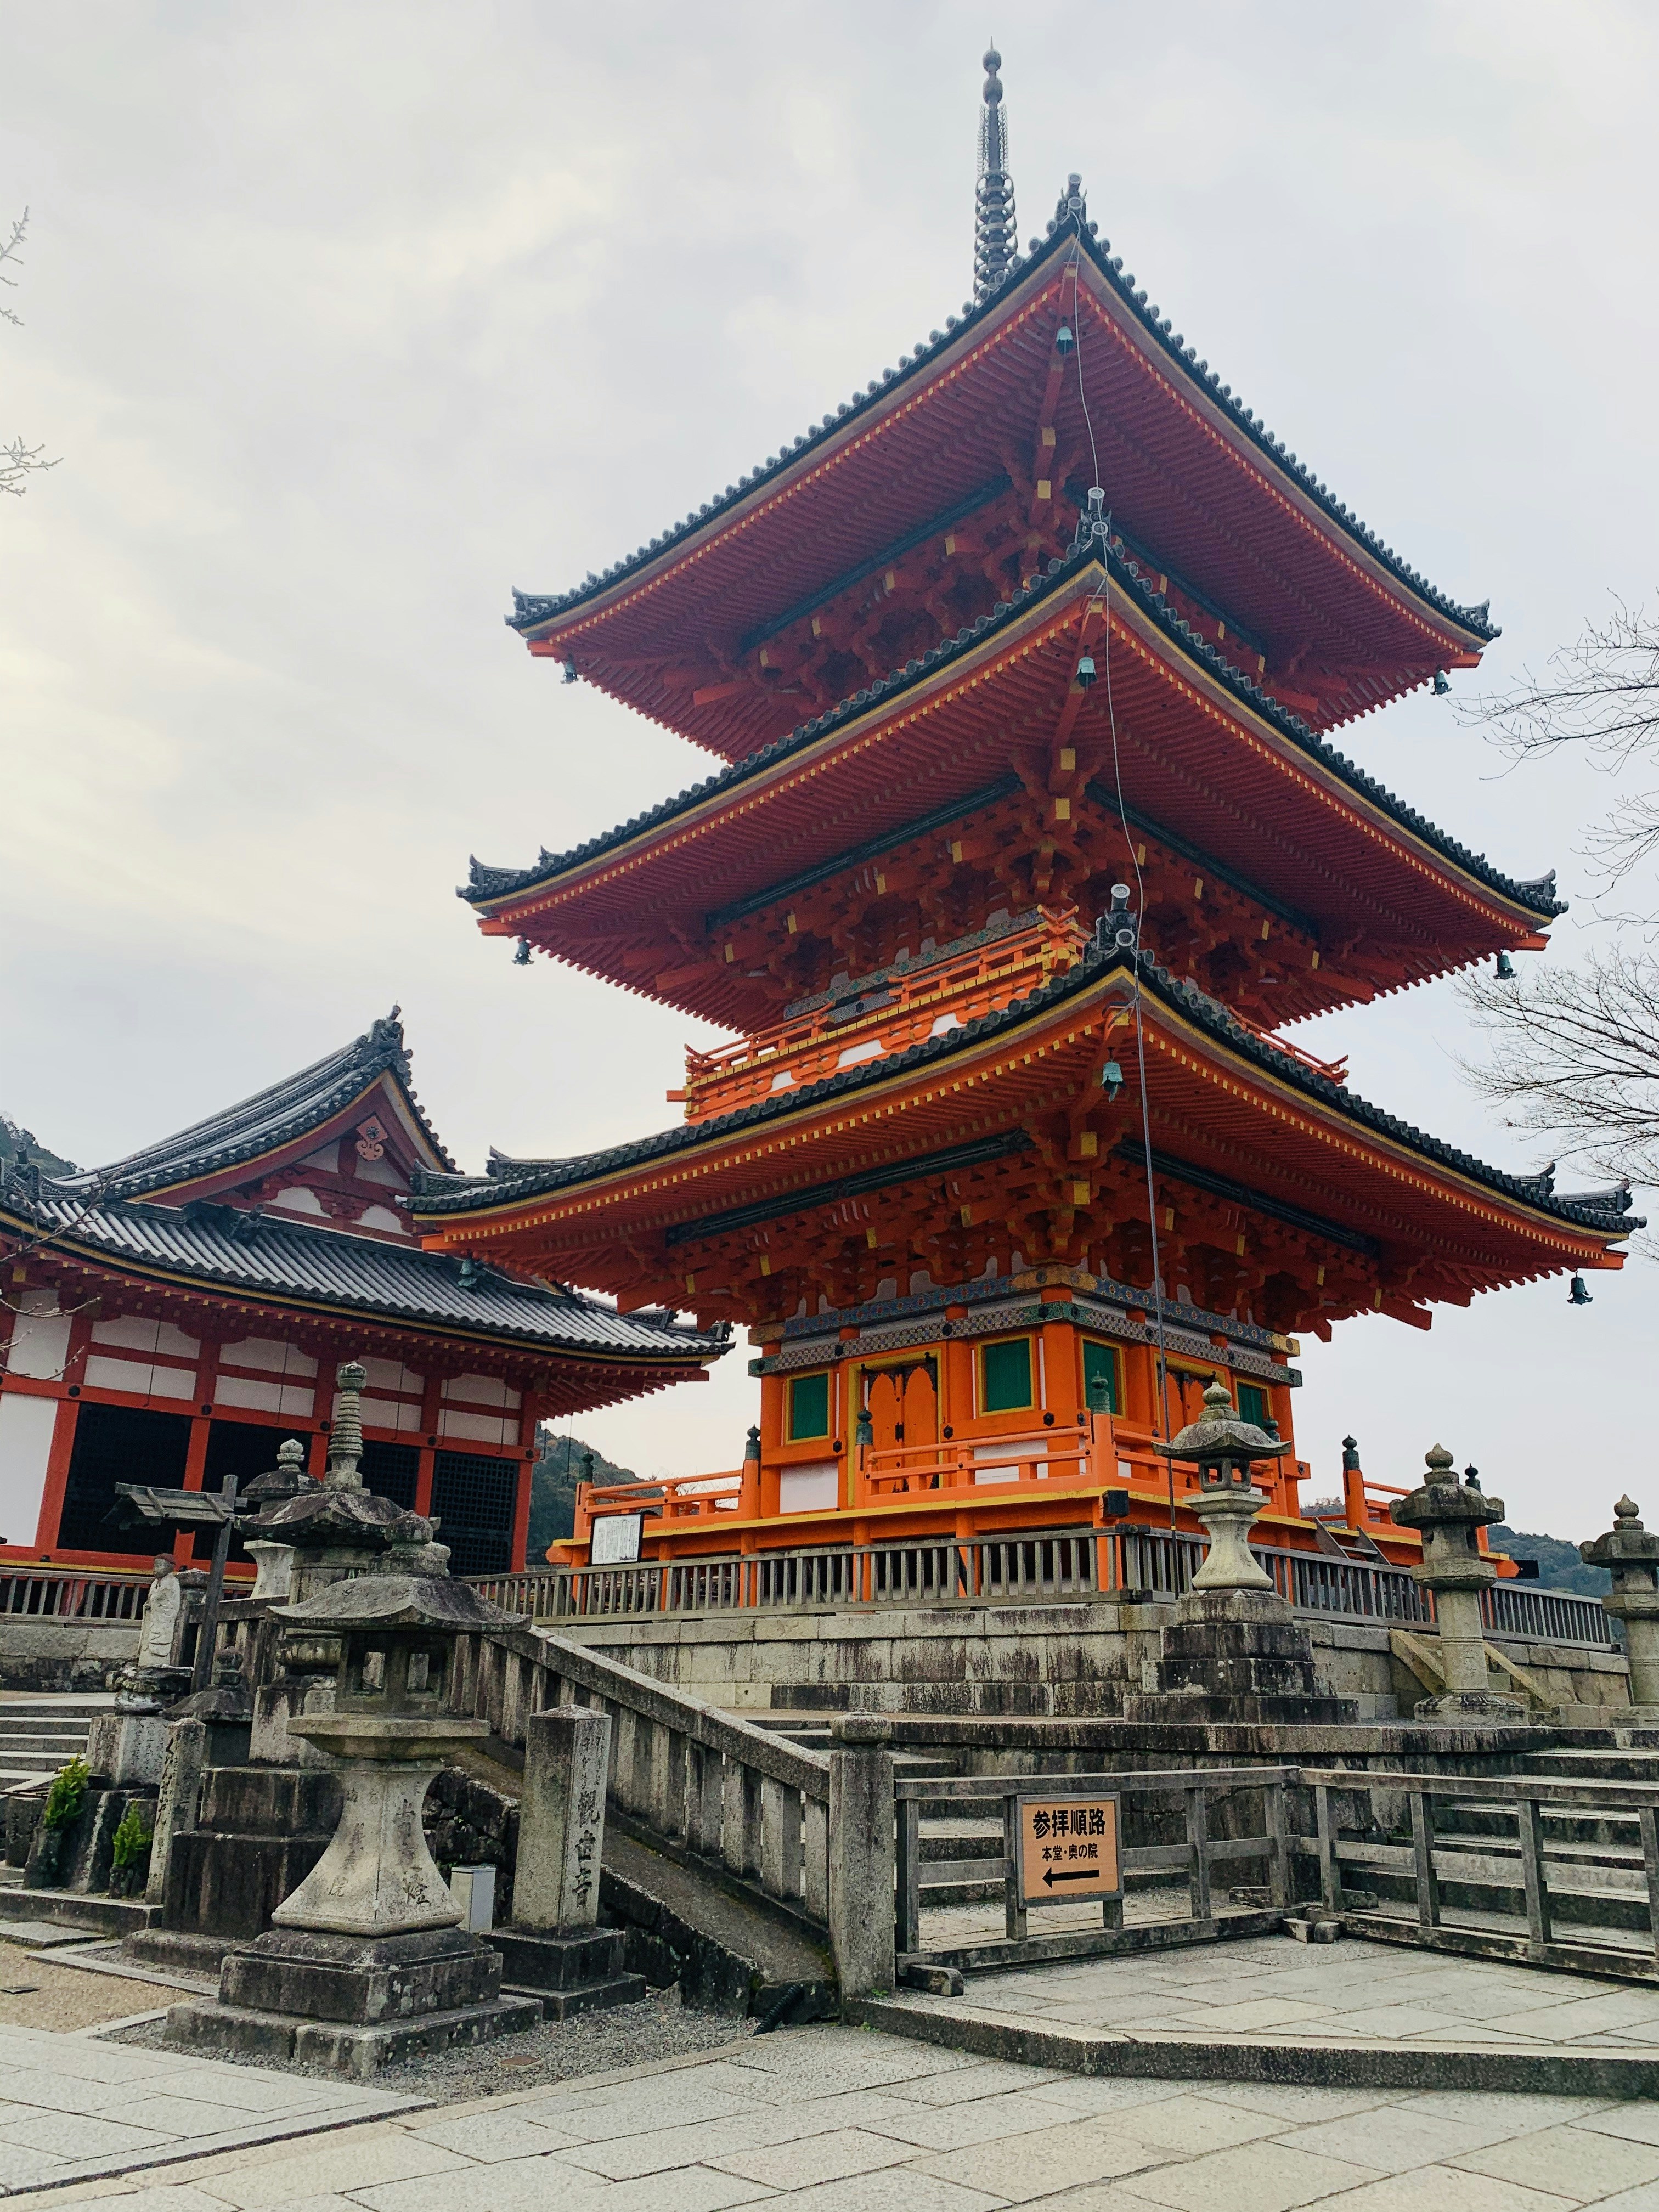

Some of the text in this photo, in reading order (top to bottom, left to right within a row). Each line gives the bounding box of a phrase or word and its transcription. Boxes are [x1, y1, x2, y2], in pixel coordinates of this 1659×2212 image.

[1032, 1808, 1106, 1839] 参拝順路
[1042, 1842, 1098, 1862] 本堂・奥の院
